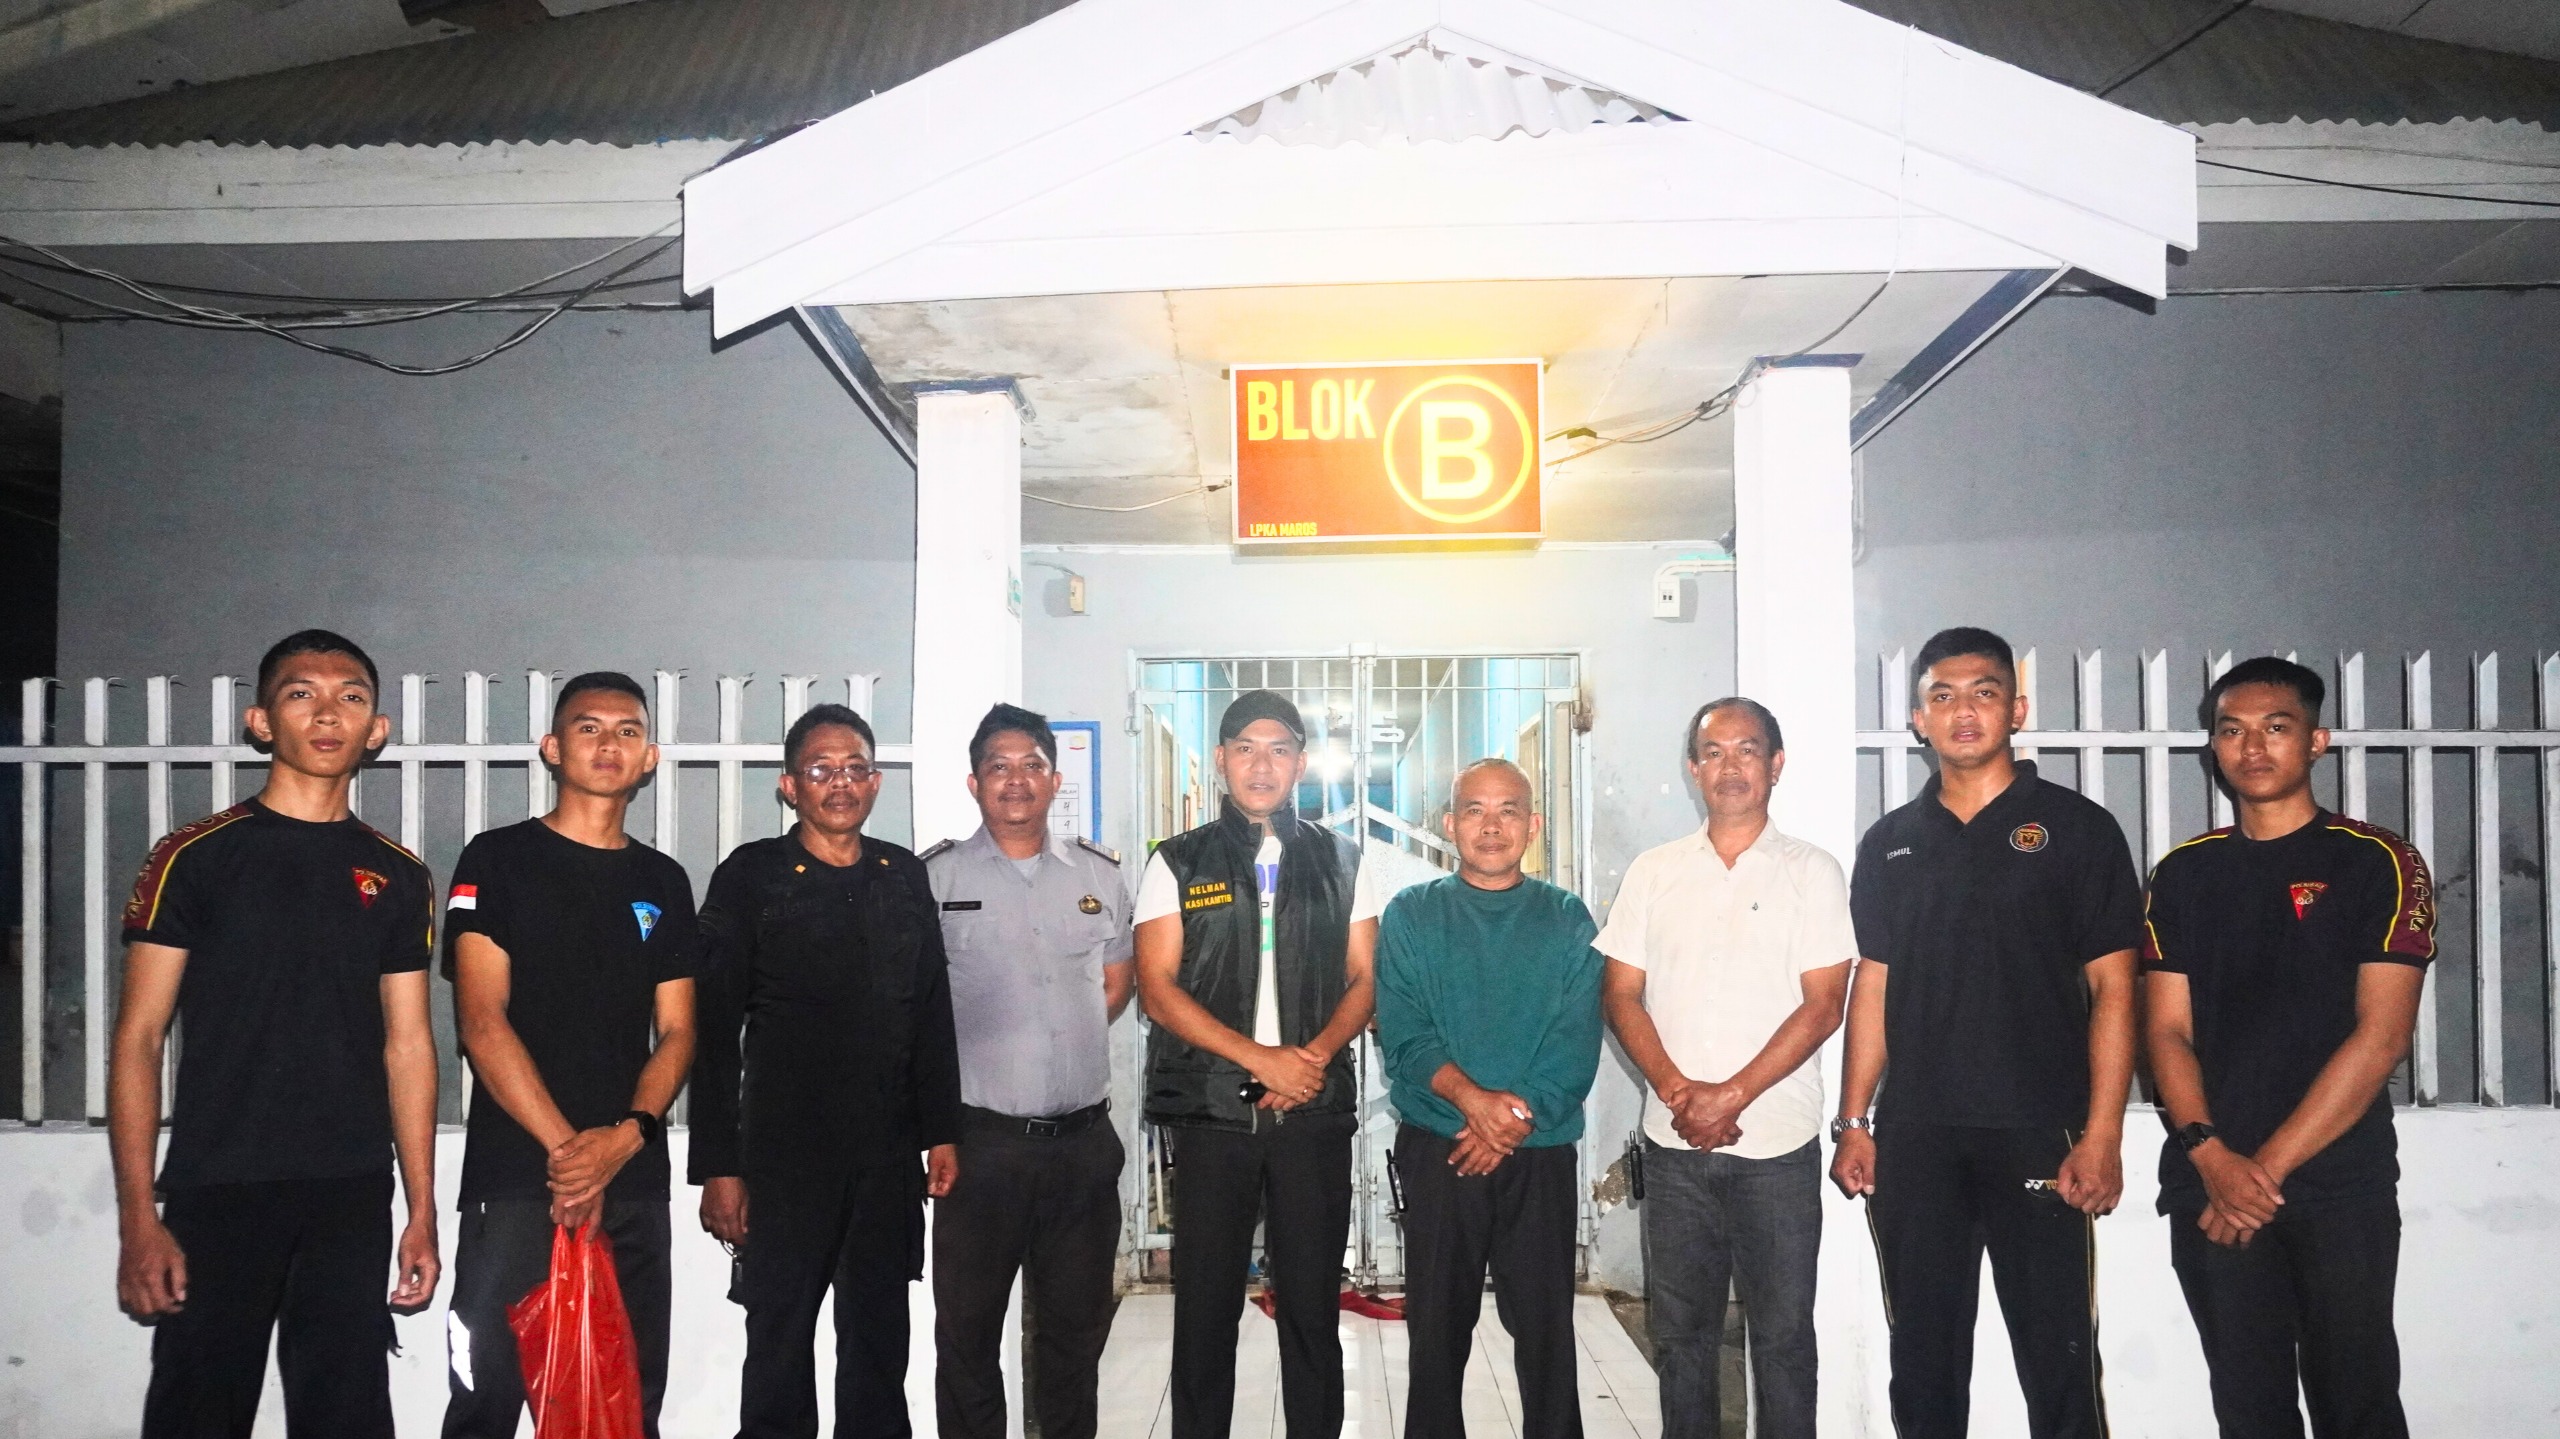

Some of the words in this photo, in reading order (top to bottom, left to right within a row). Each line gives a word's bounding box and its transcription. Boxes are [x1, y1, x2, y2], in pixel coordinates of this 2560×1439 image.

[1247, 378, 1377, 441] BLOK
[1420, 400, 1494, 500] B
[1249, 523, 1277, 537] LPKA
[1280, 521, 1318, 537] MAROS
[1887, 847, 1912, 860] ISMUL
[1189, 882, 1226, 896] NELMAN
[1185, 898, 1204, 909] KASI
[1204, 893, 1232, 906] KAMTIB
